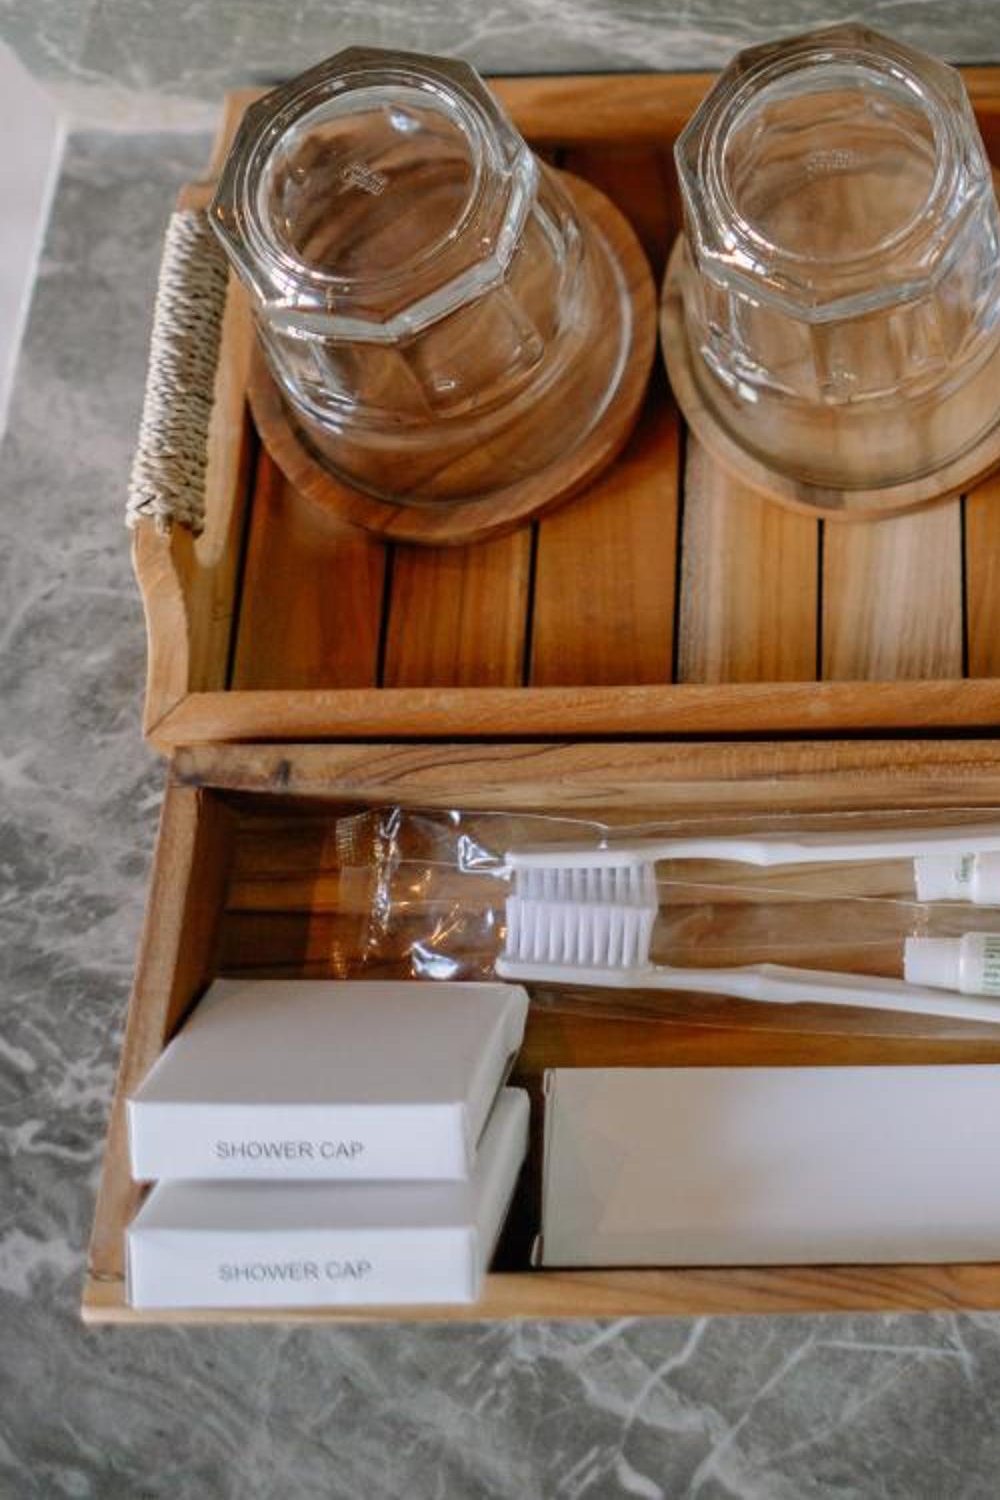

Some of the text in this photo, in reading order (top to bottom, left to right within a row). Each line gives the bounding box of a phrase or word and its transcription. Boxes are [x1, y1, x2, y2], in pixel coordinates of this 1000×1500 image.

[215, 1140, 365, 1160] SHOWER CAP
[219, 1259, 373, 1283] SHOWER CAP
